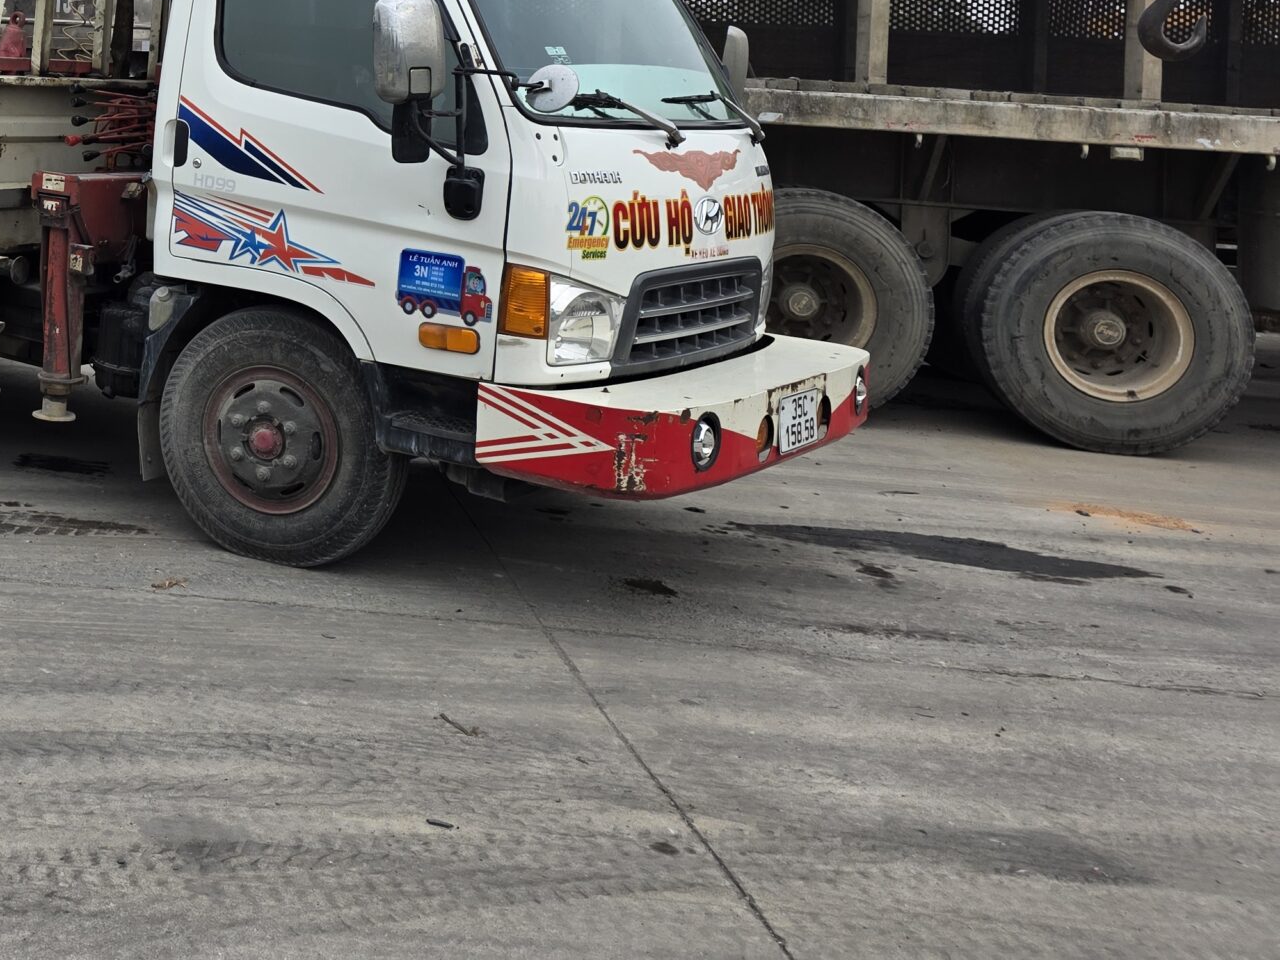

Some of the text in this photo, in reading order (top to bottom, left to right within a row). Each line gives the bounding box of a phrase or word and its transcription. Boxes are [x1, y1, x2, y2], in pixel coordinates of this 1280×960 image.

[193, 173, 236, 192] HD99
[612, 190, 660, 252] CỨU
[665, 189, 693, 256] HỘ
[723, 194, 751, 240] GIAO
[567, 235, 609, 250] Emergency
[409, 254, 419, 262] LÊ
[441, 259, 458, 268] ANH
[581, 249, 607, 260] Services
[414, 265, 428, 278] 3N
[791, 395, 808, 420] 35C
[785, 417, 815, 448] 158.58
